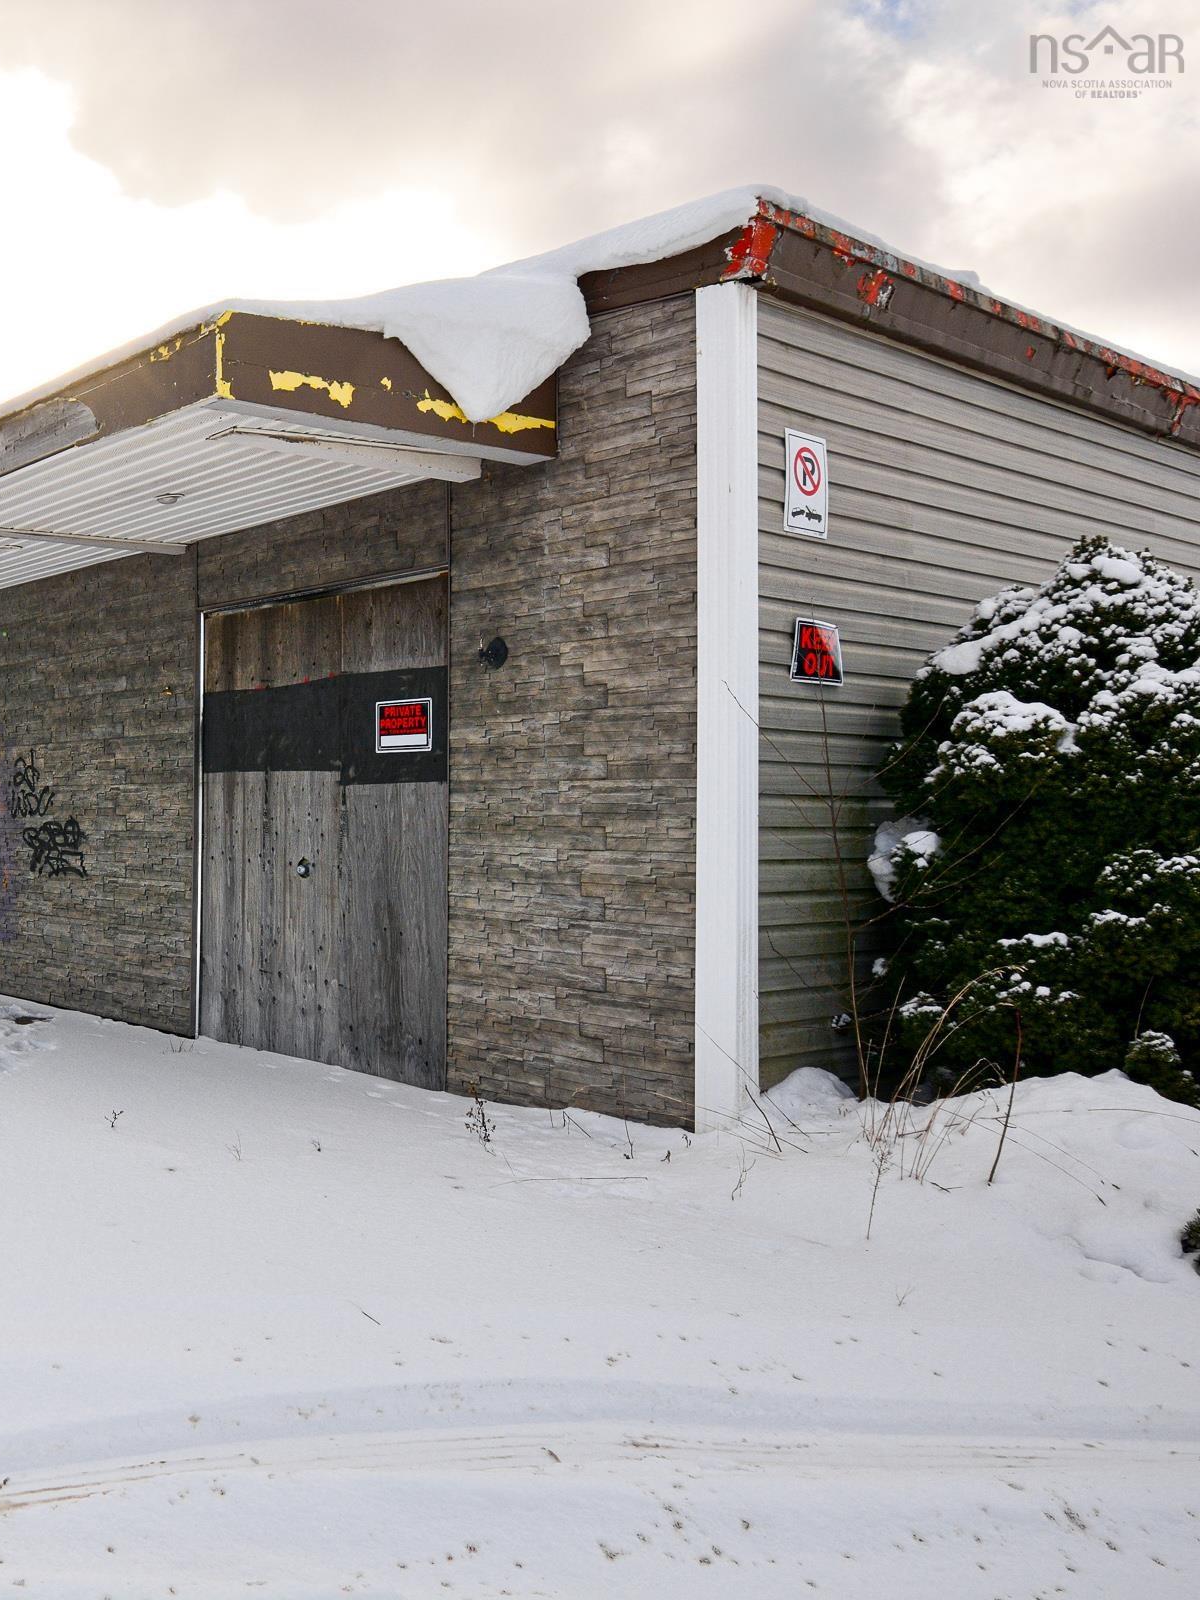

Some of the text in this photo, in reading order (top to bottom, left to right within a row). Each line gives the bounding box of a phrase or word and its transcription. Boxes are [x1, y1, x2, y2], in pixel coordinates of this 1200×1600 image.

[803, 652, 835, 678] OUT
[383, 704, 422, 717] PRIVATE
[380, 716, 427, 729] PROPERTY
